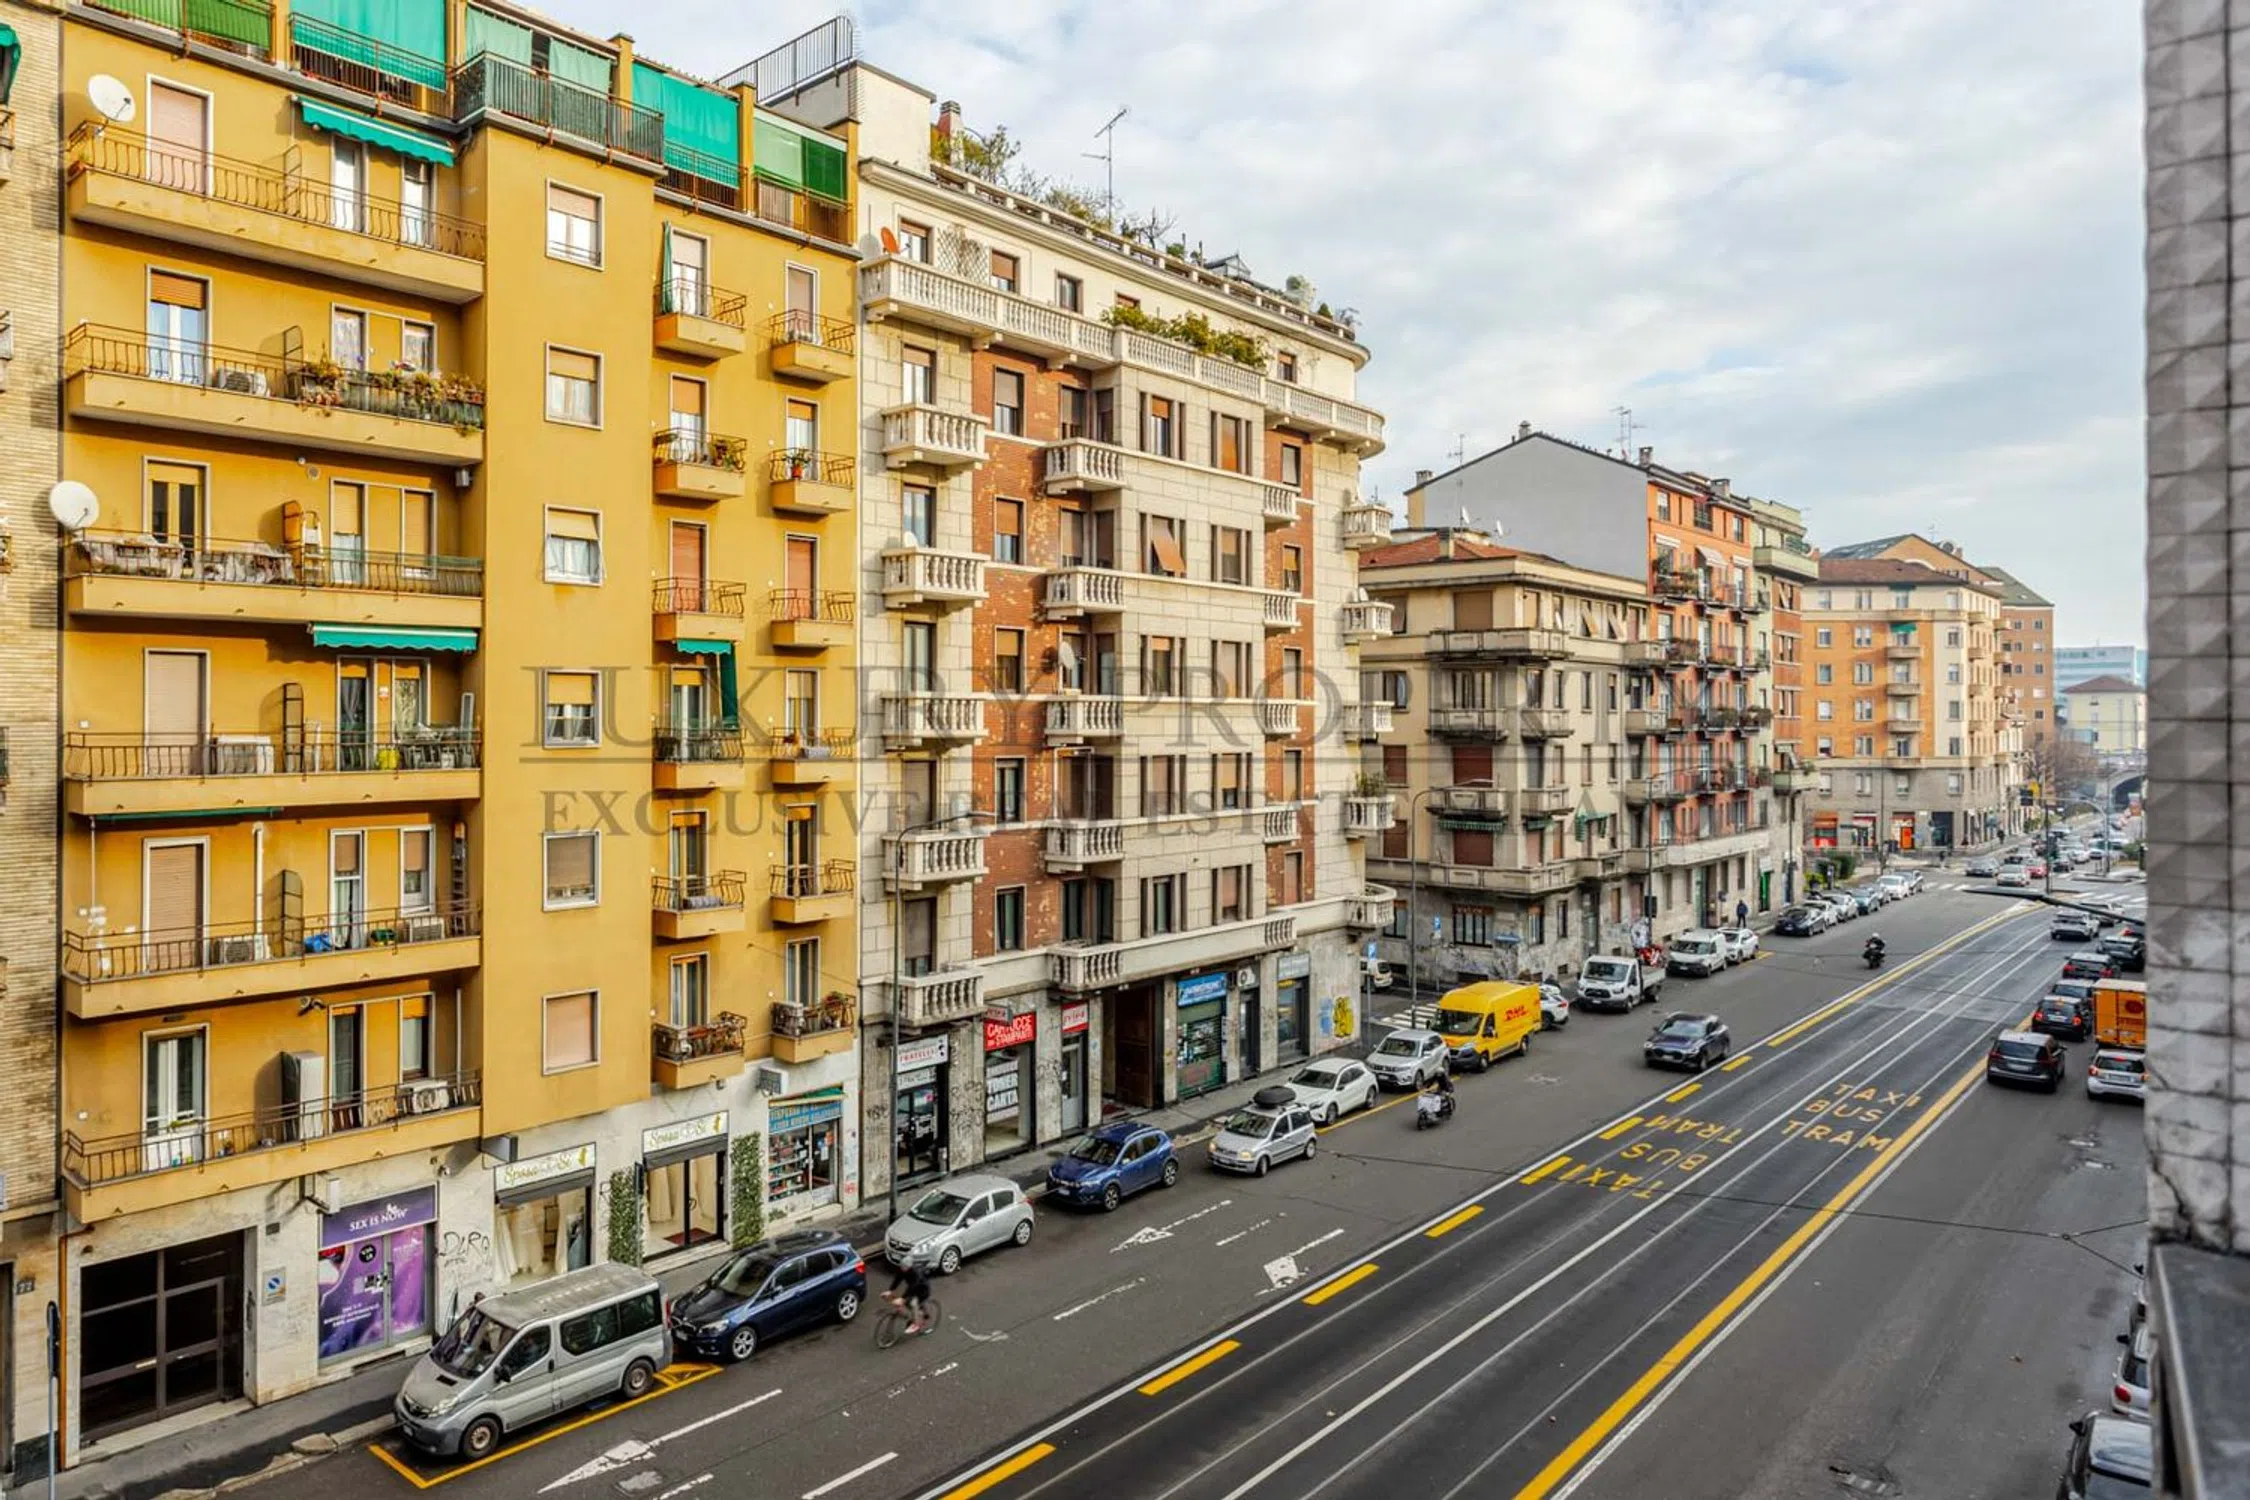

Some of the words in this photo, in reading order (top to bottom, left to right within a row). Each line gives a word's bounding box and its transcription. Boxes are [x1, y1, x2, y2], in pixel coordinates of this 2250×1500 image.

[1804, 1099, 1885, 1121] BUS
[1833, 1083, 1921, 1108] TAXI
[1644, 1114, 1742, 1144] TRAM
[1781, 1119, 1893, 1152] TRAM
[1620, 1142, 1708, 1171] BUS
[1558, 1163, 1664, 1199] TAXI
[349, 1218, 368, 1232] SEX
[380, 1207, 409, 1225] NOW
